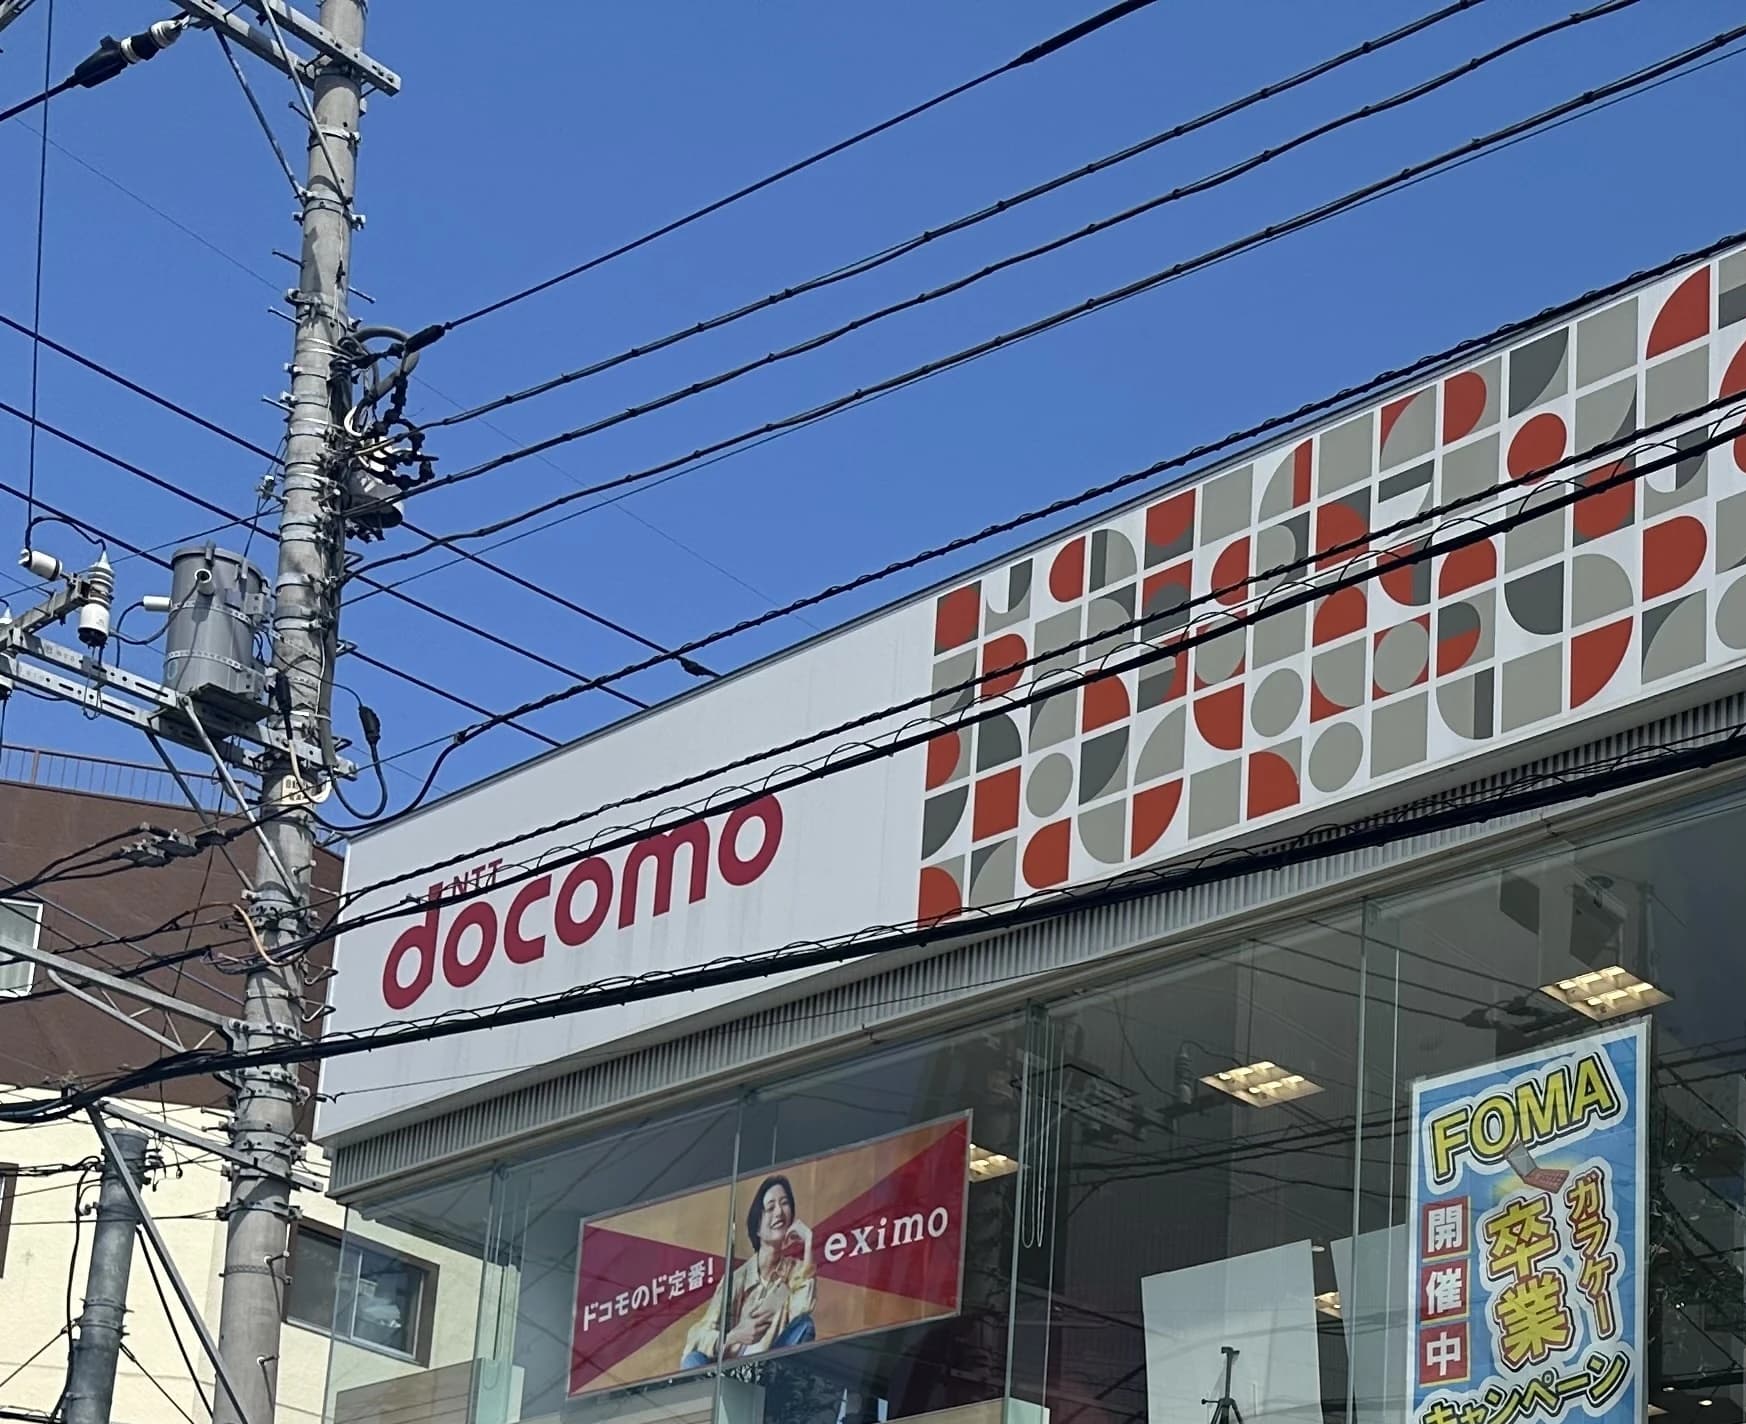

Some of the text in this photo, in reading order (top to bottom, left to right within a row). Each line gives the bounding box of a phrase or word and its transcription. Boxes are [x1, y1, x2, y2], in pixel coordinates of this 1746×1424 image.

[382, 793, 784, 1010] docomo
[453, 857, 503, 896] NTT
[1430, 1054, 1620, 1186] FOMA
[823, 1205, 950, 1263] eximo
[1425, 1206, 1464, 1378] 開催中
[1484, 1195, 1575, 1371] 卒業
[1566, 1168, 1617, 1340] ガラケー
